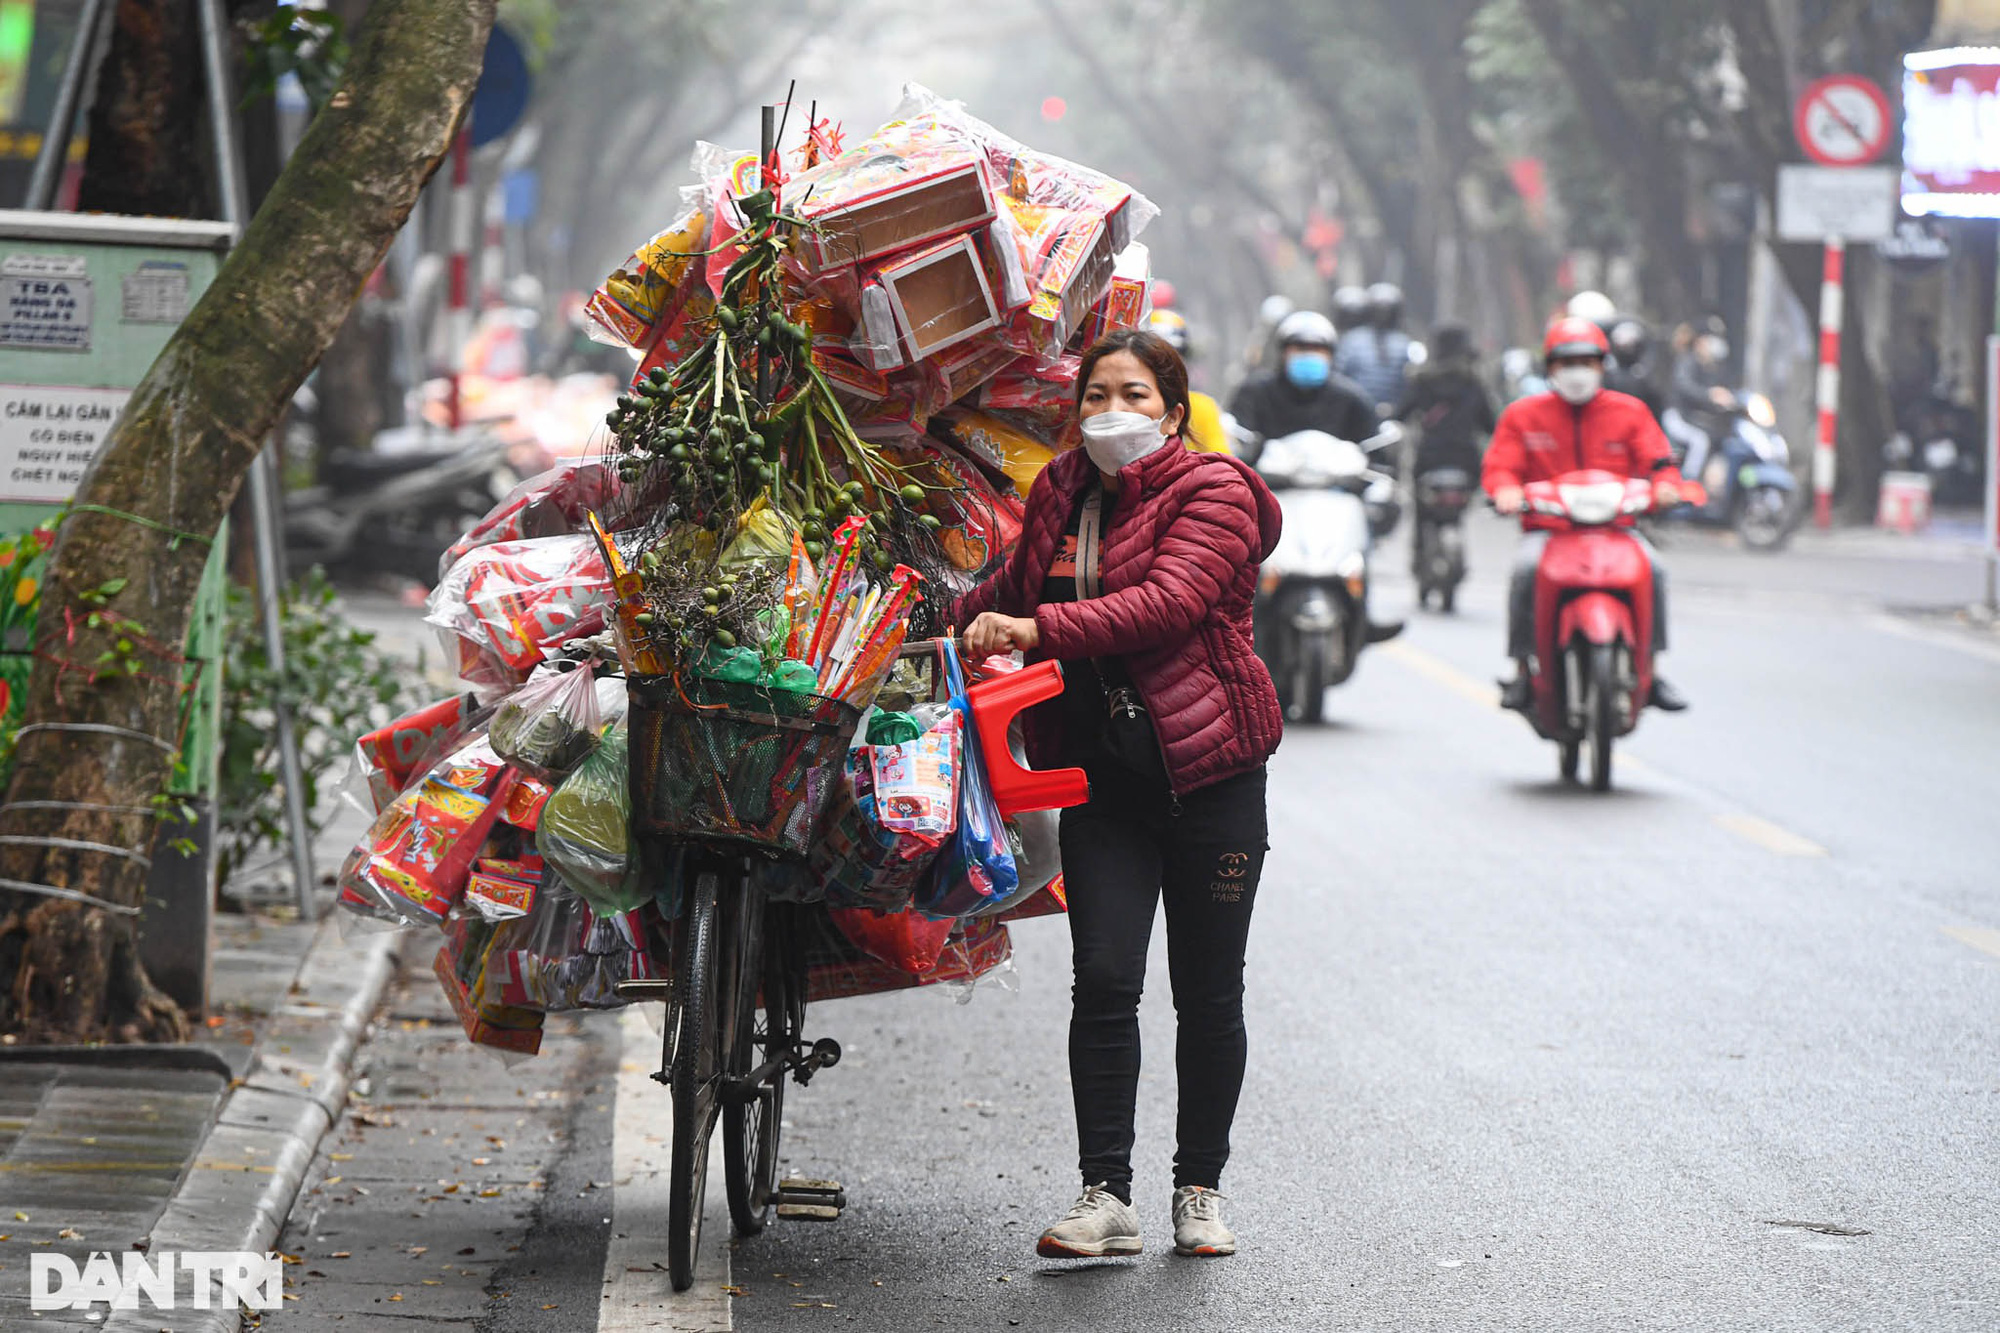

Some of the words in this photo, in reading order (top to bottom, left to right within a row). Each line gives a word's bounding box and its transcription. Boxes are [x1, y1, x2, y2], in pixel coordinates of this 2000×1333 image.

[17, 281, 69, 294] TBA
[1210, 882, 1245, 892] CHANEL
[1212, 892, 1241, 902] PARIS
